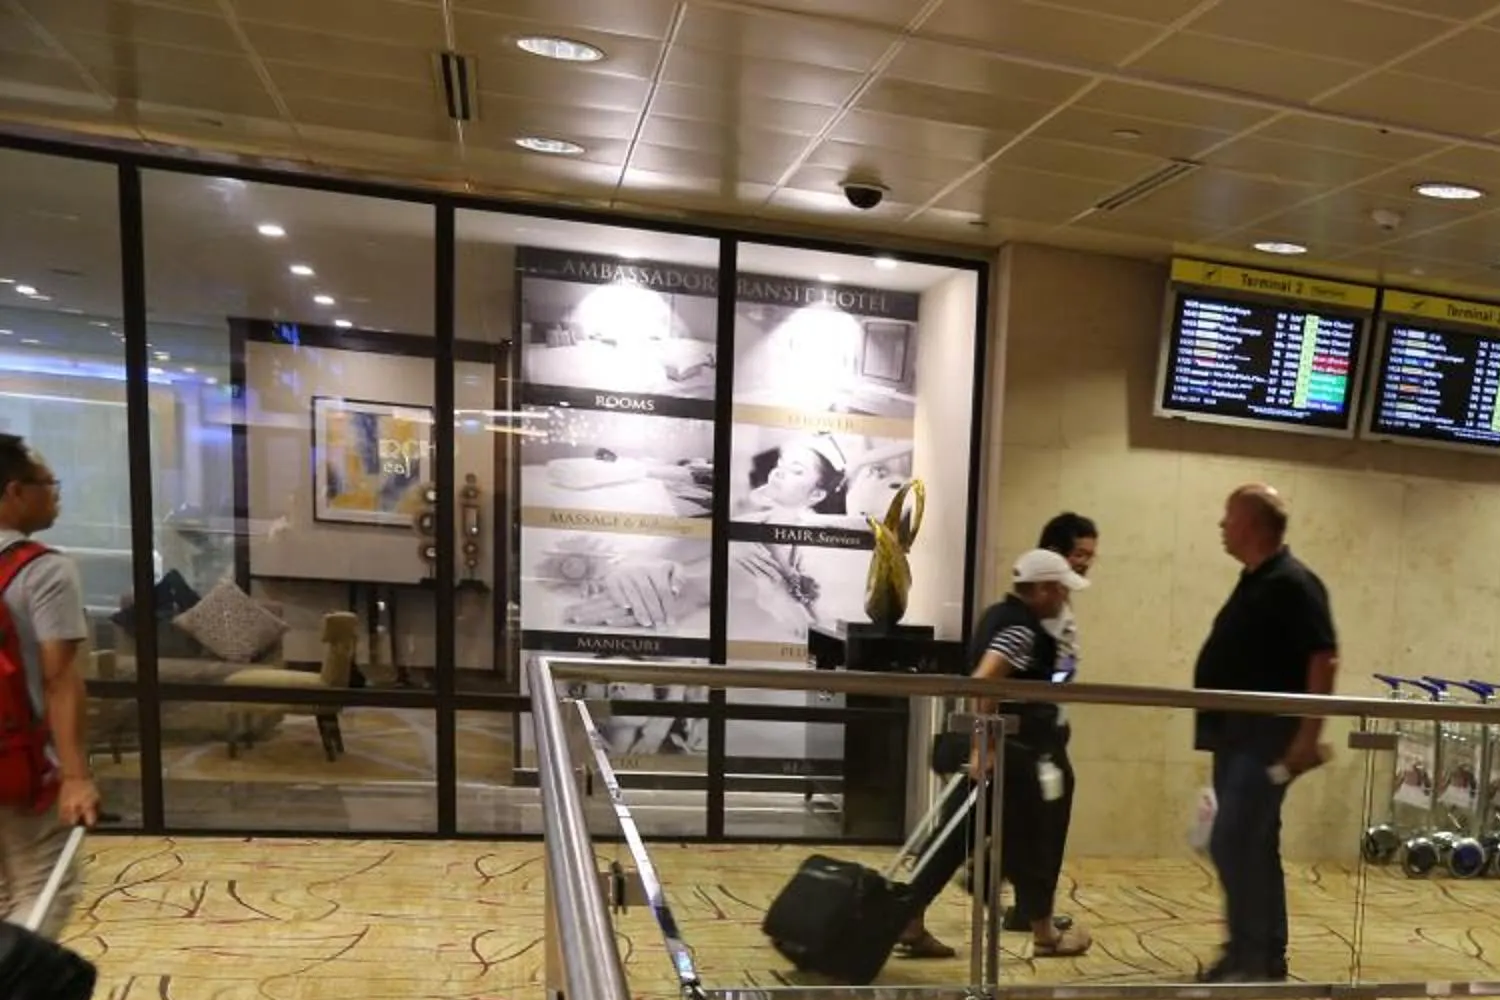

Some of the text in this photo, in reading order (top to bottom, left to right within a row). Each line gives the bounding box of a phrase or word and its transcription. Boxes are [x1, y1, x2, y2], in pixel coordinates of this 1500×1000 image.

[563, 259, 890, 314] AMBASSADOR RANSIT HOTEL
[1446, 303, 1494, 322] Terminal
[595, 395, 656, 411] ROOMS
[774, 527, 813, 542] HAIR
[577, 636, 661, 652] MANICURE
